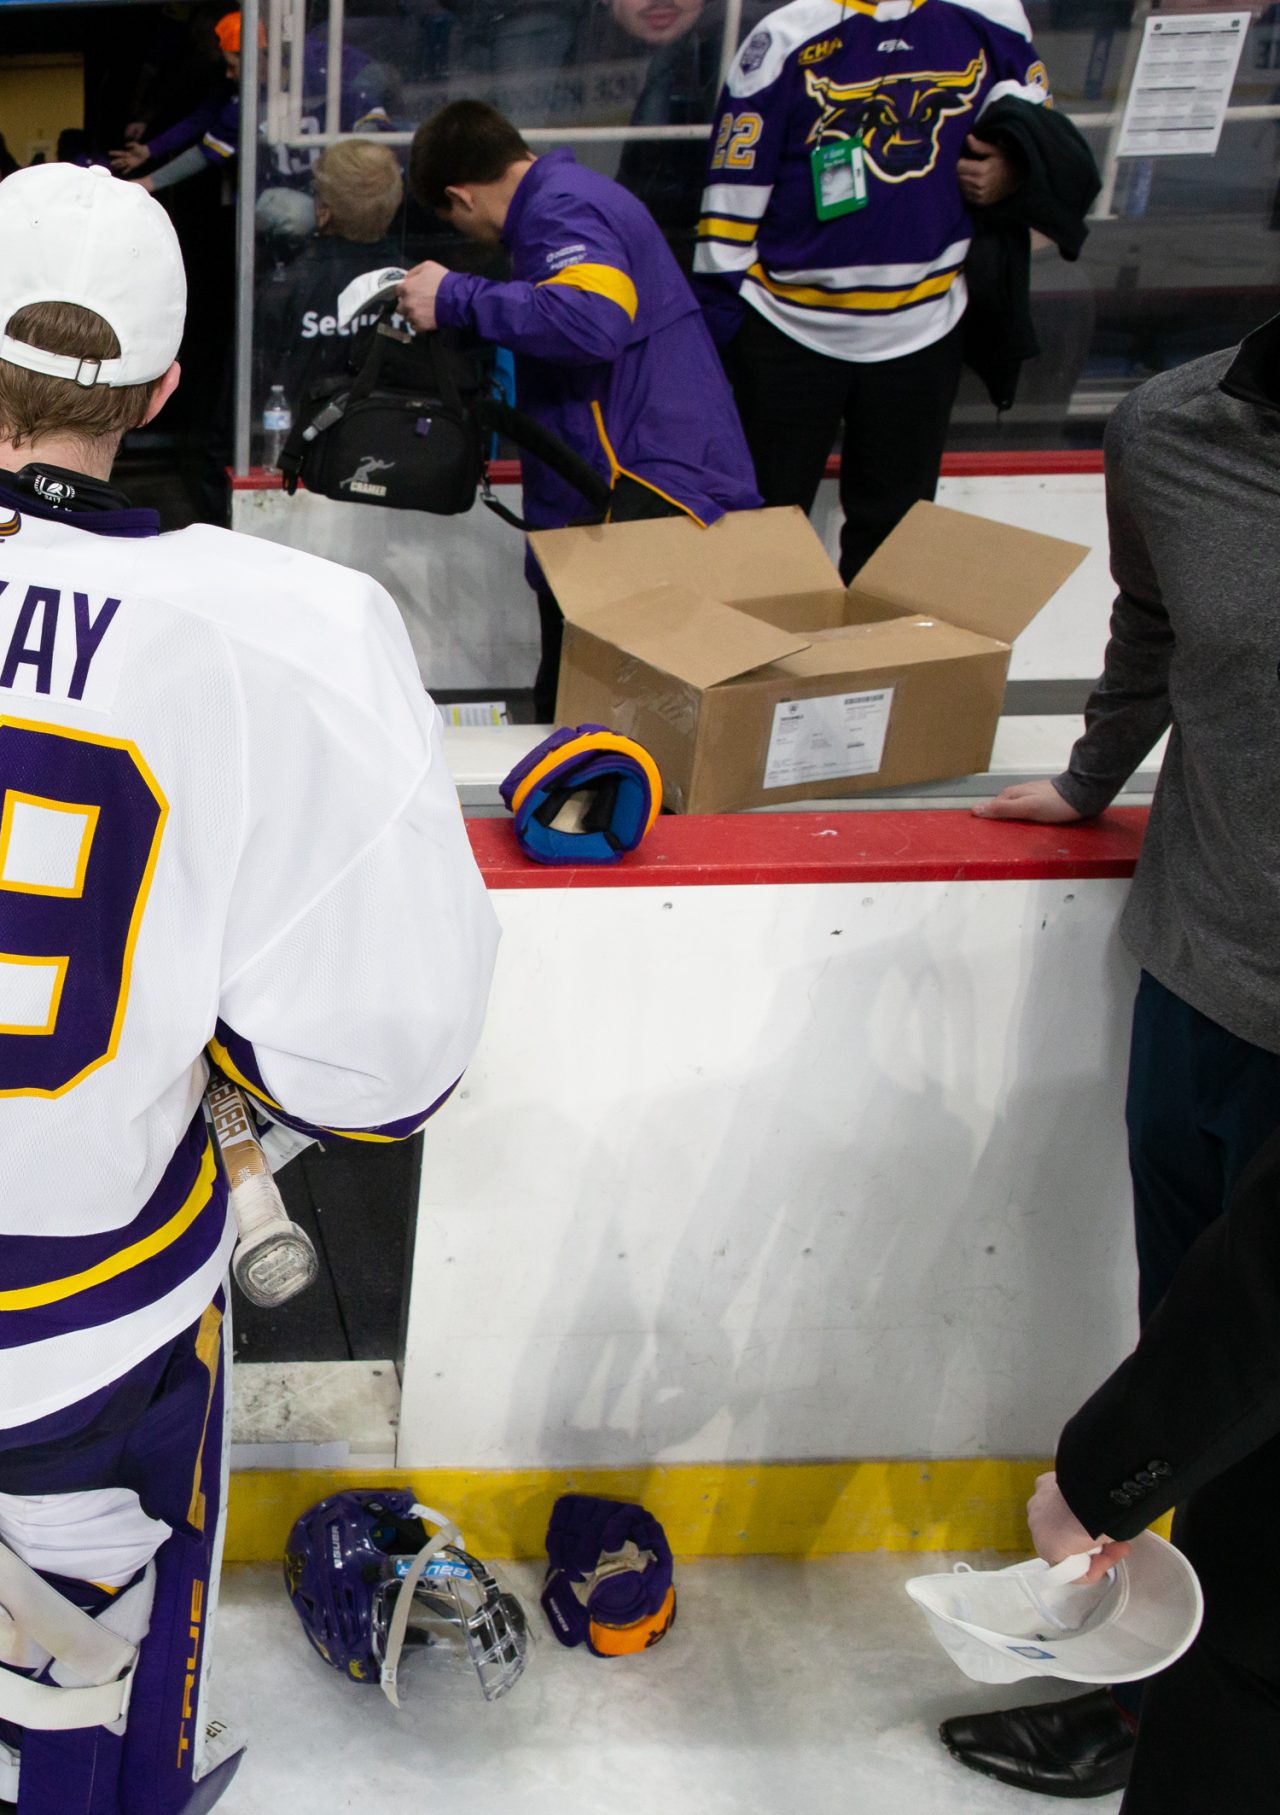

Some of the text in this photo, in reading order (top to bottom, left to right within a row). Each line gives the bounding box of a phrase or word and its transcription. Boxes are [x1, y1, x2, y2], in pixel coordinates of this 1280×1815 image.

[710, 112, 764, 170] 22
[301, 311, 417, 338] Securt
[400, 1560, 469, 1578] BAUR
[176, 1578, 205, 1769] TRUE
